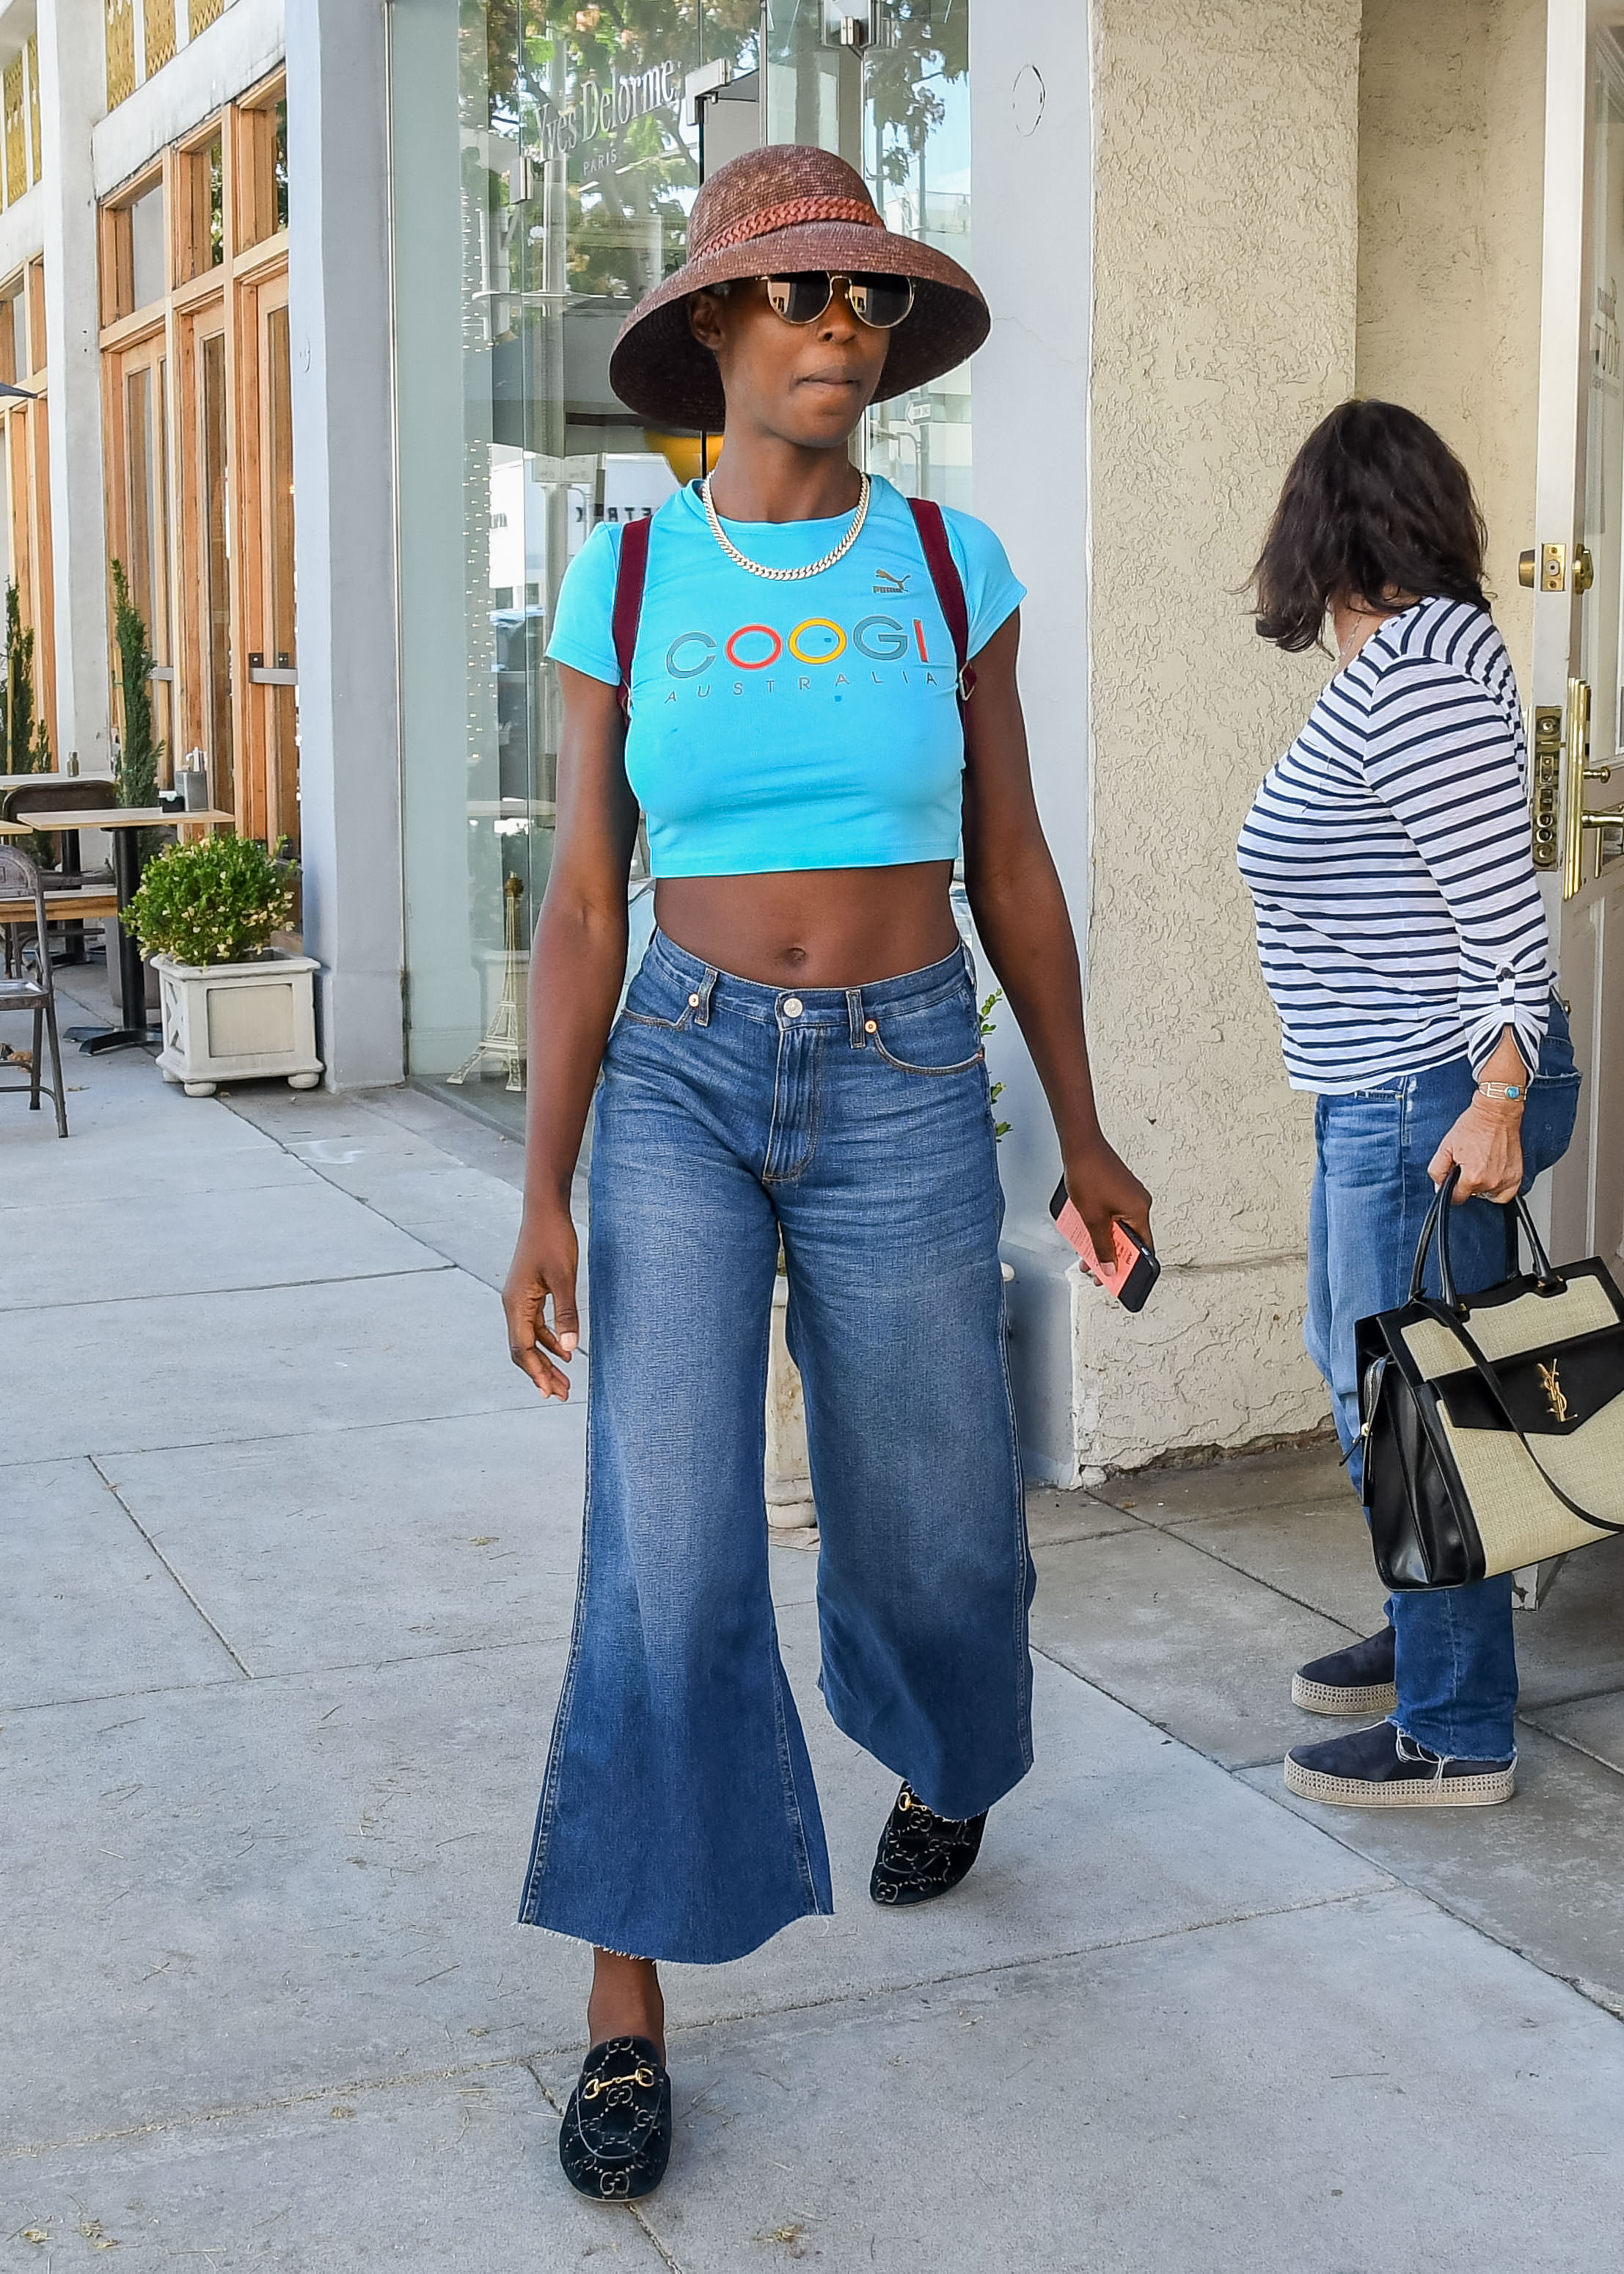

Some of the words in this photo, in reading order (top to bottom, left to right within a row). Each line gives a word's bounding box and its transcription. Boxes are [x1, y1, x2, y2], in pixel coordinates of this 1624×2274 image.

[535, 103, 578, 164] Yves
[581, 59, 676, 143] Delorme
[583, 149, 618, 176] PARIS
[665, 615, 929, 679] COOGI
[664, 670, 938, 704] AUSTRALIA
